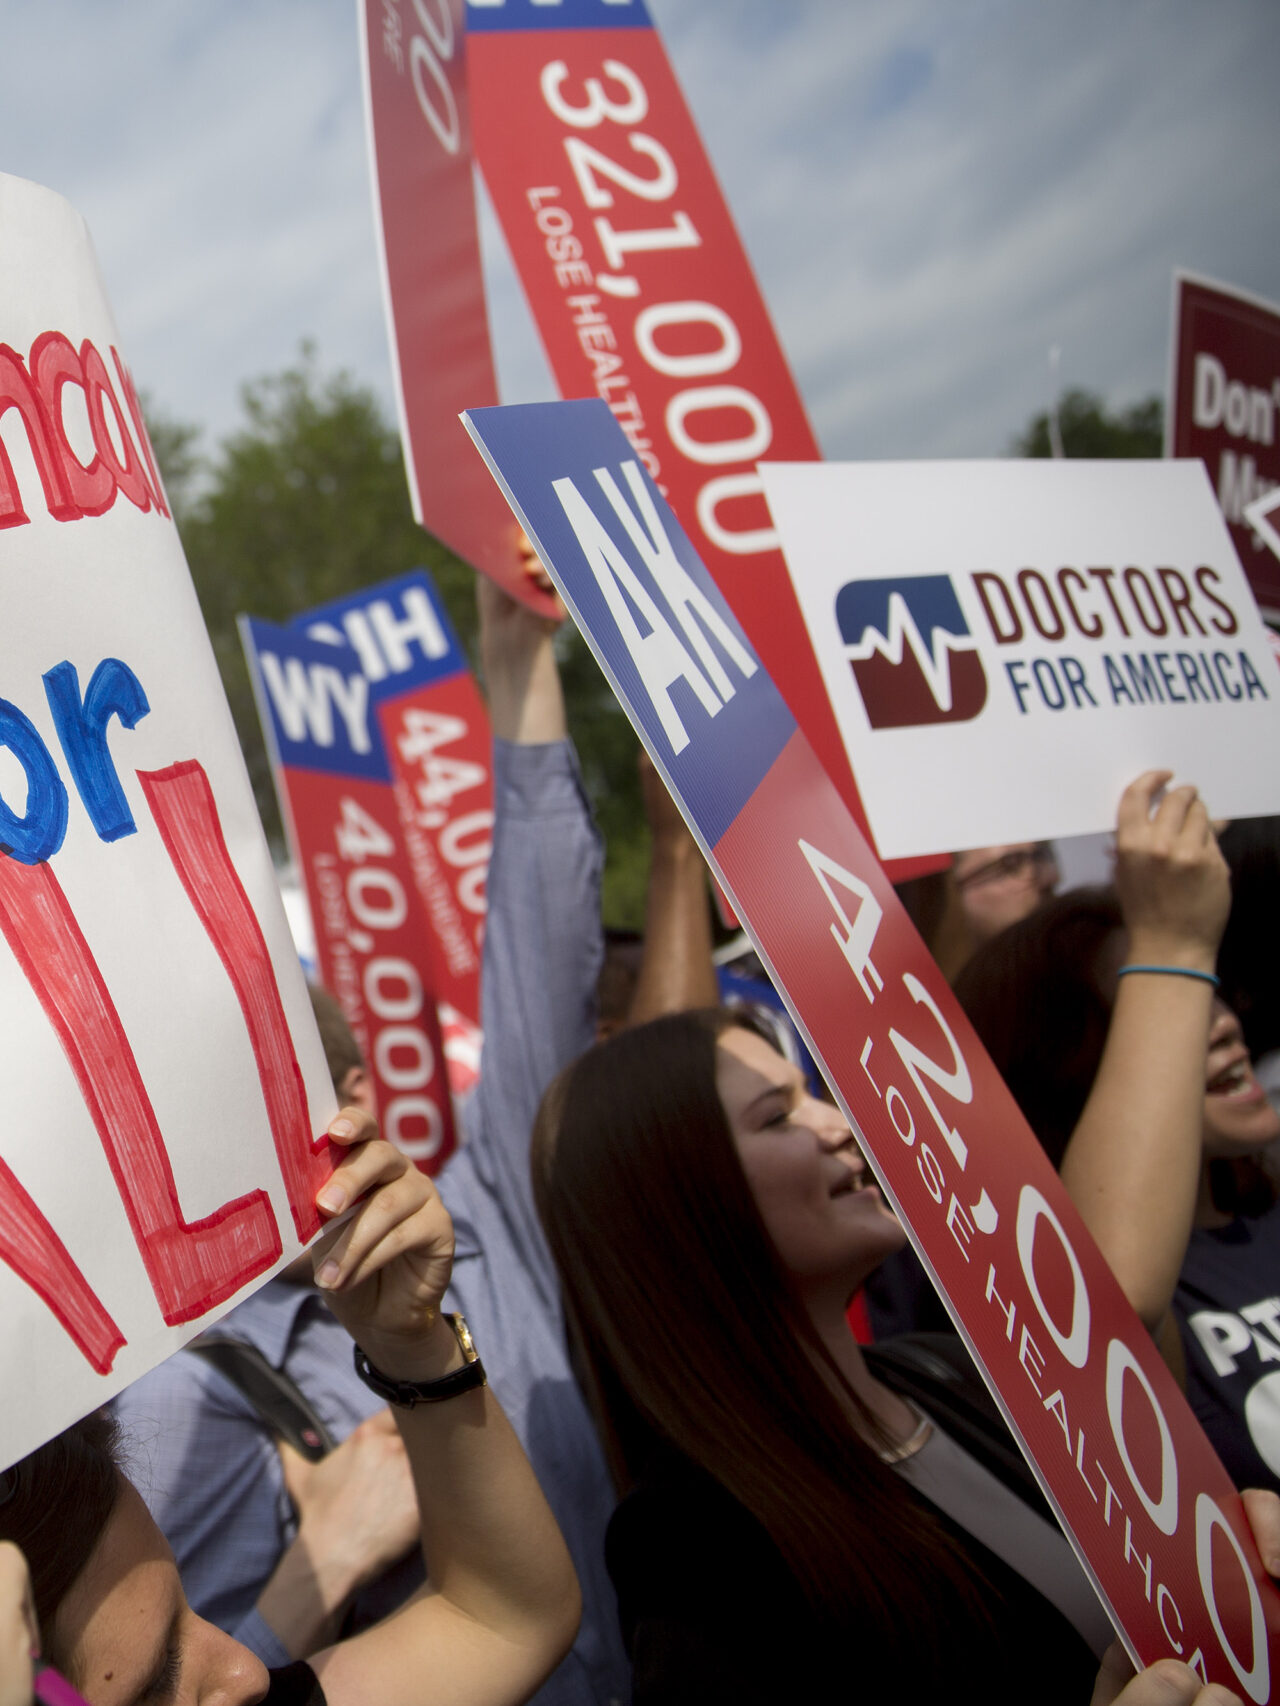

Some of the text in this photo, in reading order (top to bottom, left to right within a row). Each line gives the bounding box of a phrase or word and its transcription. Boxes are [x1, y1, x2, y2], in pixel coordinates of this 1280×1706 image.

[526, 185, 666, 500] LOSE HEALTHC
[540, 58, 784, 555] 321,000
[260, 648, 372, 757] WY
[551, 460, 759, 757] AK
[970, 564, 1240, 645] DOCTORS
[1004, 648, 1270, 715] FOR AMERICA
[335, 796, 445, 1161] 40,000
[798, 837, 1270, 1706] 42,000
[858, 1036, 972, 1263] LOSE
